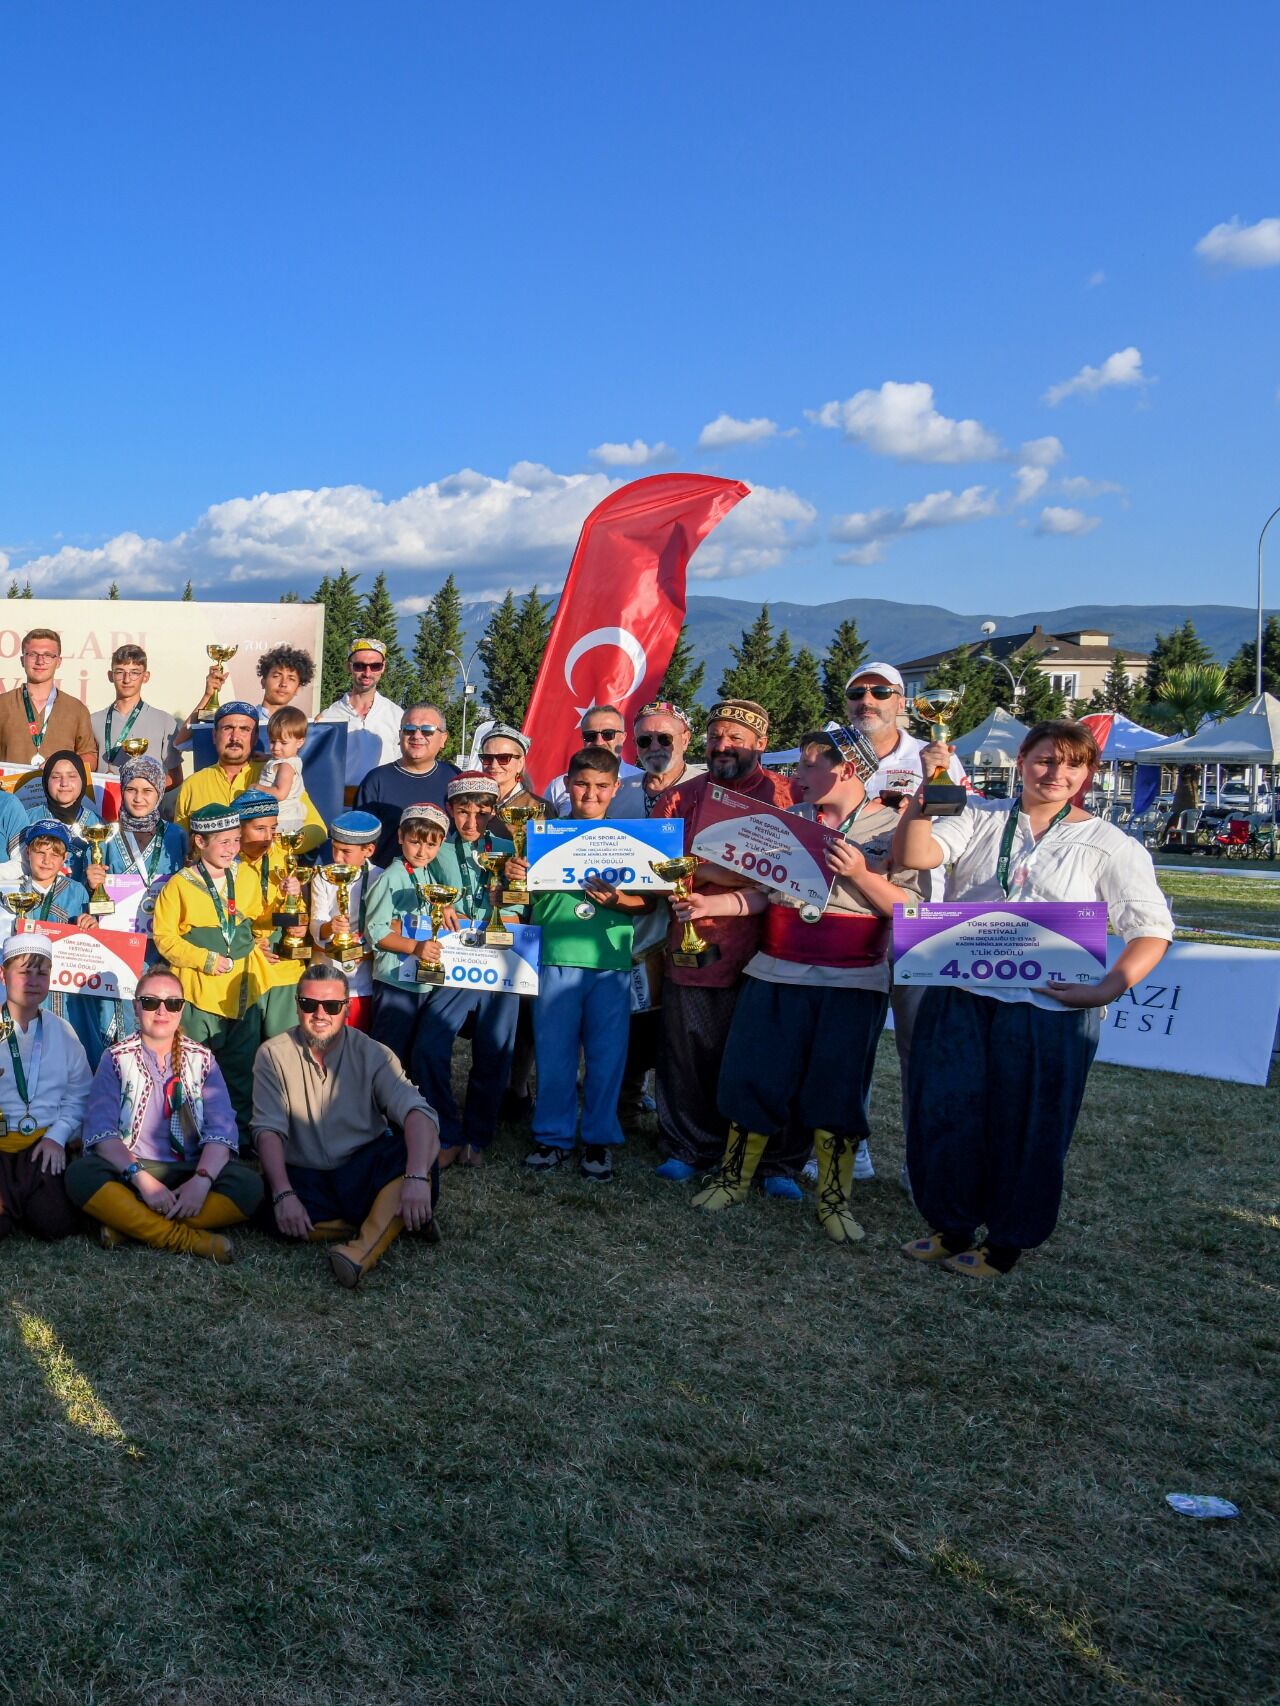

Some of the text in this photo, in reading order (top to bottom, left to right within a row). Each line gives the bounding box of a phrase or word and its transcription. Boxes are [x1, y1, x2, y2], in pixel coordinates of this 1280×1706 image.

[721, 843, 801, 892] 3.000 TL
[641, 876, 653, 884] TL
[993, 948, 1024, 956] ÖDÜLÜ
[52, 970, 115, 992] .000 TL
[445, 965, 514, 987] .000 TL
[939, 959, 1066, 982] 4.000 TL
